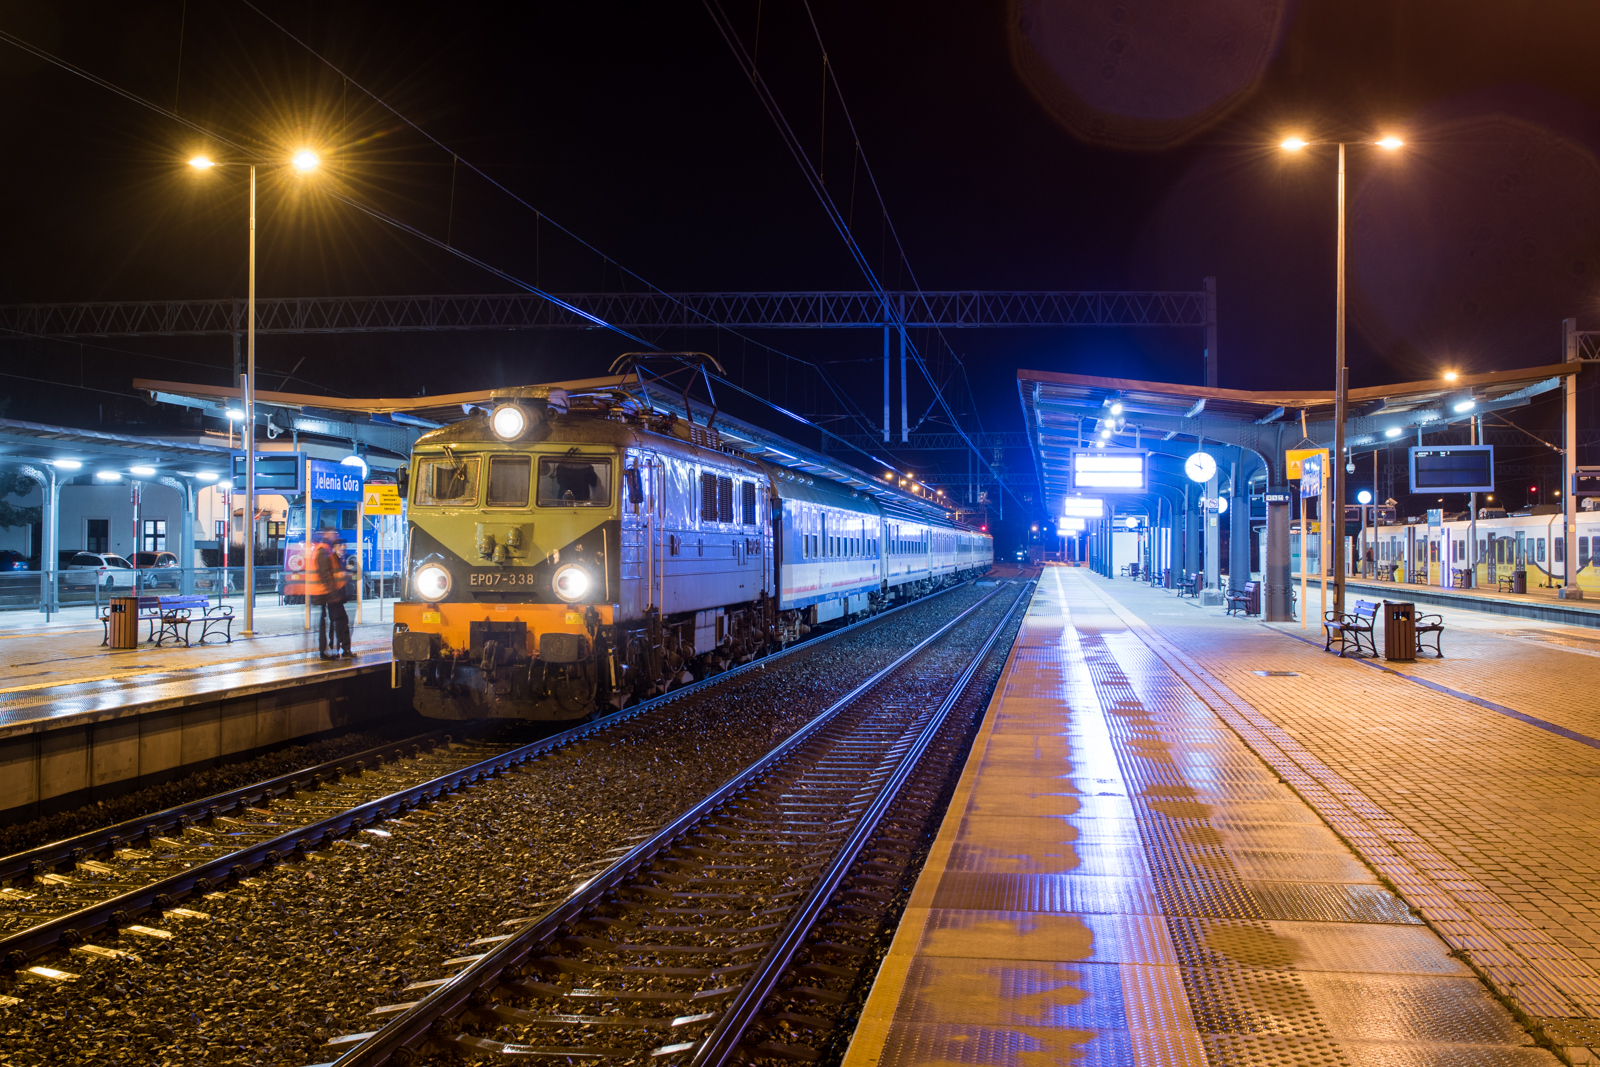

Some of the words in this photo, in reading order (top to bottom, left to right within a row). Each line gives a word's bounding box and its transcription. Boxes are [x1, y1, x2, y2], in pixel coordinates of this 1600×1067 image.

[315, 472, 341, 490] Jelenia
[342, 474, 359, 492] Góra
[470, 573, 534, 586] EP07-338
